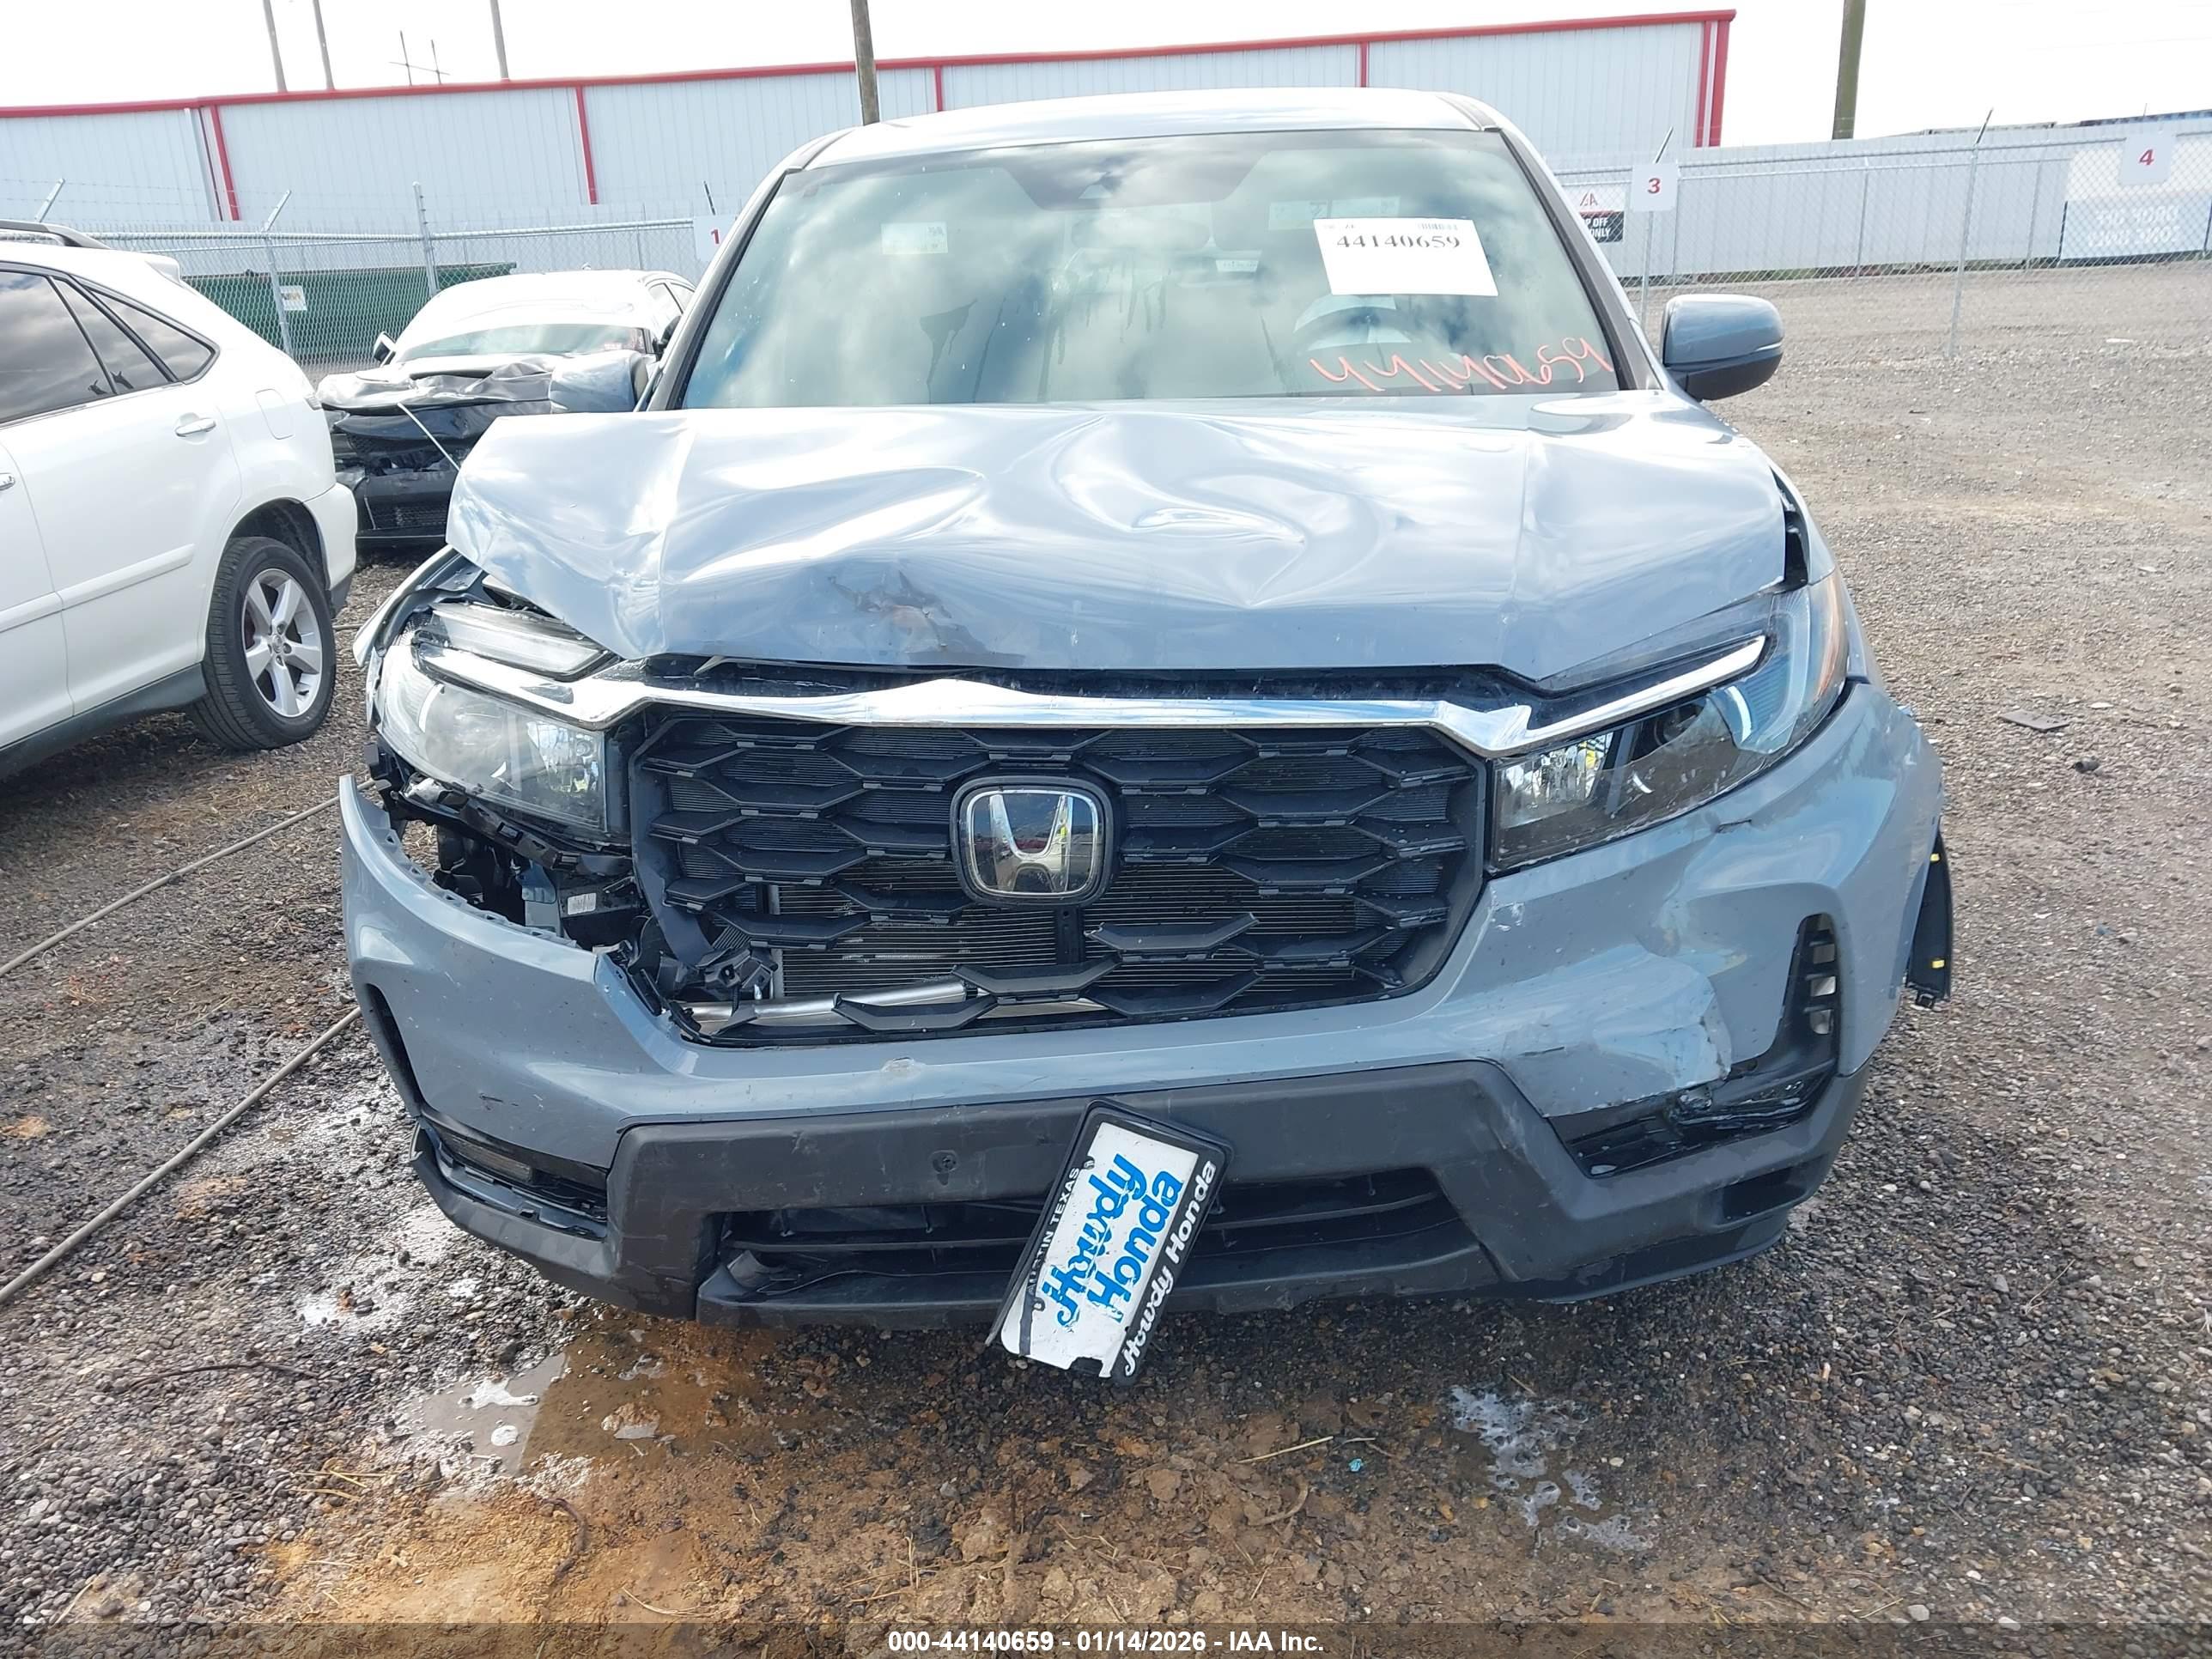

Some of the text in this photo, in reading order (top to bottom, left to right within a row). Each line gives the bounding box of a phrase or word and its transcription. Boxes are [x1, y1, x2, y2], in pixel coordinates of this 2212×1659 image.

[2137, 149, 2155, 166] 4
[1647, 178, 1661, 194] 3
[1592, 218, 1608, 228] OFF
[710, 228, 720, 245] 1
[1336, 234, 1461, 249] 44140659
[1050, 1167, 1080, 1225] TEXAS
[1040, 1152, 1147, 1328] Howdy
[1085, 1170, 1184, 1323] Honda
[1124, 1160, 1217, 1376] Howdy Honda
